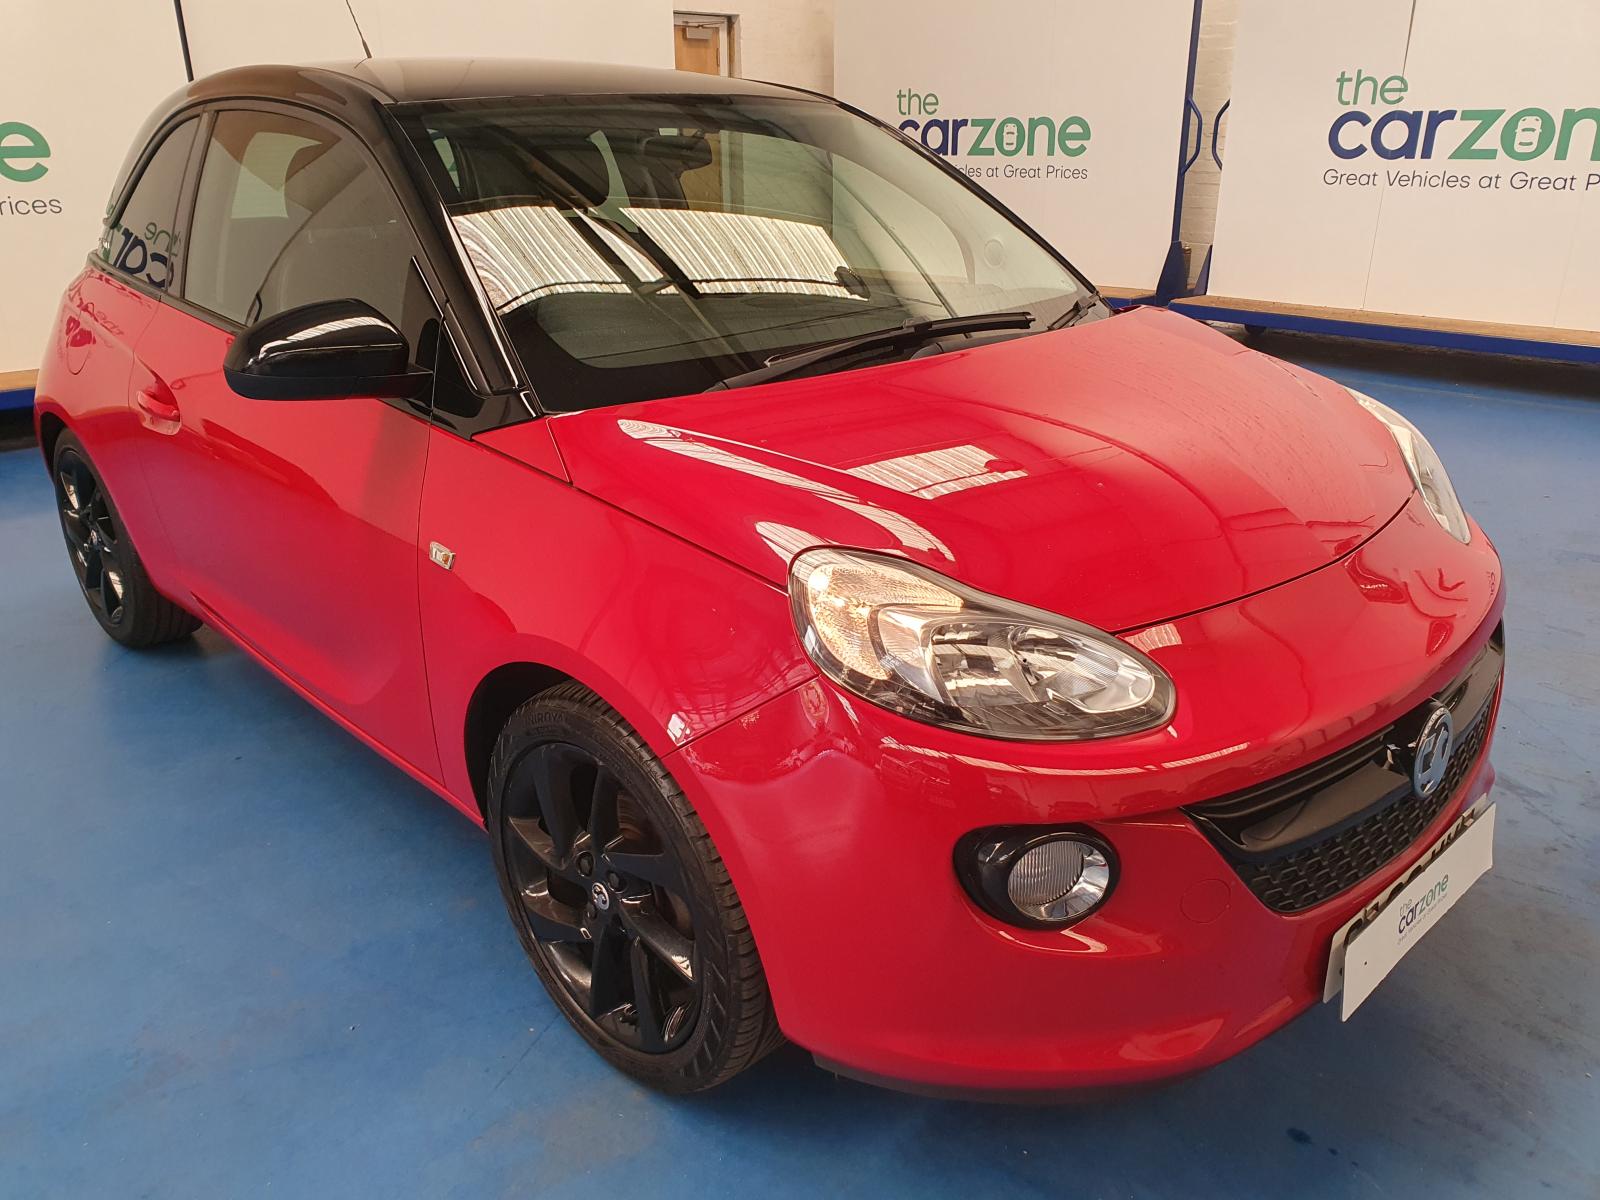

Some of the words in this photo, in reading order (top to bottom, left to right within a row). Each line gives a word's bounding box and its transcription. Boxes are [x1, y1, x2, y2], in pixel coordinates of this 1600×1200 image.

[1336, 69, 1408, 105] the
[897, 88, 939, 115] the
[986, 166, 999, 178] at
[1004, 164, 1041, 179] Great
[1046, 165, 1088, 180] Prices
[1323, 168, 1378, 186] Great
[1386, 170, 1471, 188] Vehicles
[1478, 174, 1501, 189] at
[1510, 171, 1577, 191] Great
[1398, 874, 1449, 934] carzone
